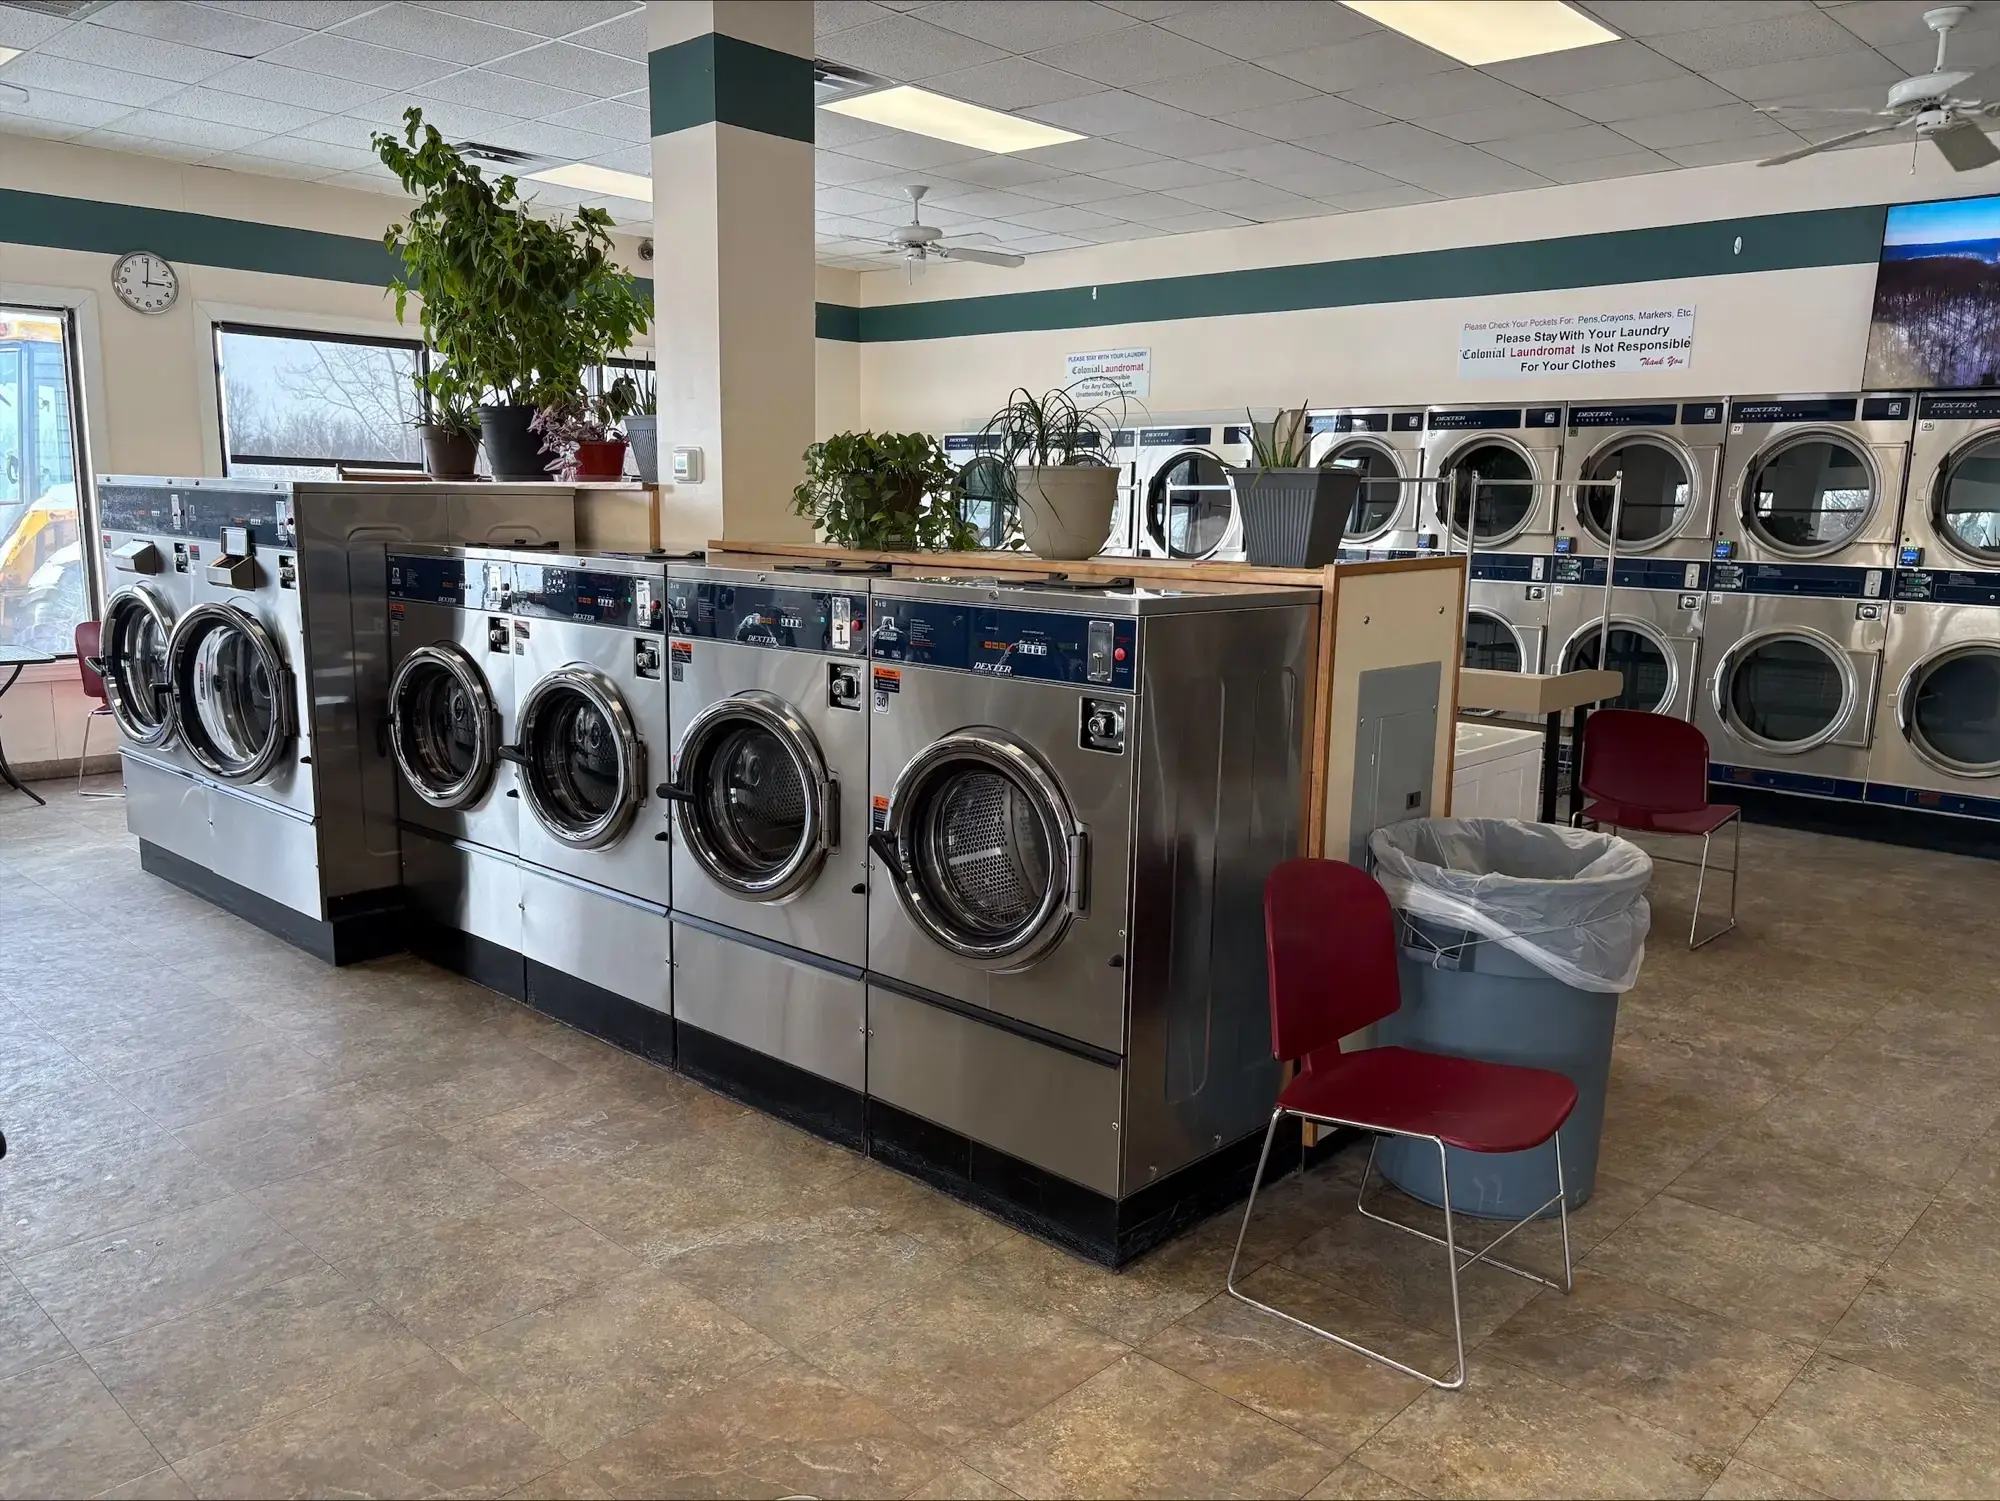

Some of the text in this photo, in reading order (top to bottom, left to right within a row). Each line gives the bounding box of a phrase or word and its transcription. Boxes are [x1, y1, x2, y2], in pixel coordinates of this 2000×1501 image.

[1530, 318, 1557, 327] Pockets
[1677, 308, 1693, 317] Etc.
[1496, 325, 1670, 343] Please Stay With Your Laundry
[1462, 338, 1691, 359] Colonial Laundromat Is Not Responsible
[1521, 359, 1615, 372] For Your Clothes
[1640, 356, 1683, 367] Thank You
[1072, 363, 1144, 374] Colonial Laundromat
[748, 635, 777, 643] DEXTER
[974, 662, 1012, 673] DEXTER
[876, 696, 886, 707] 30
